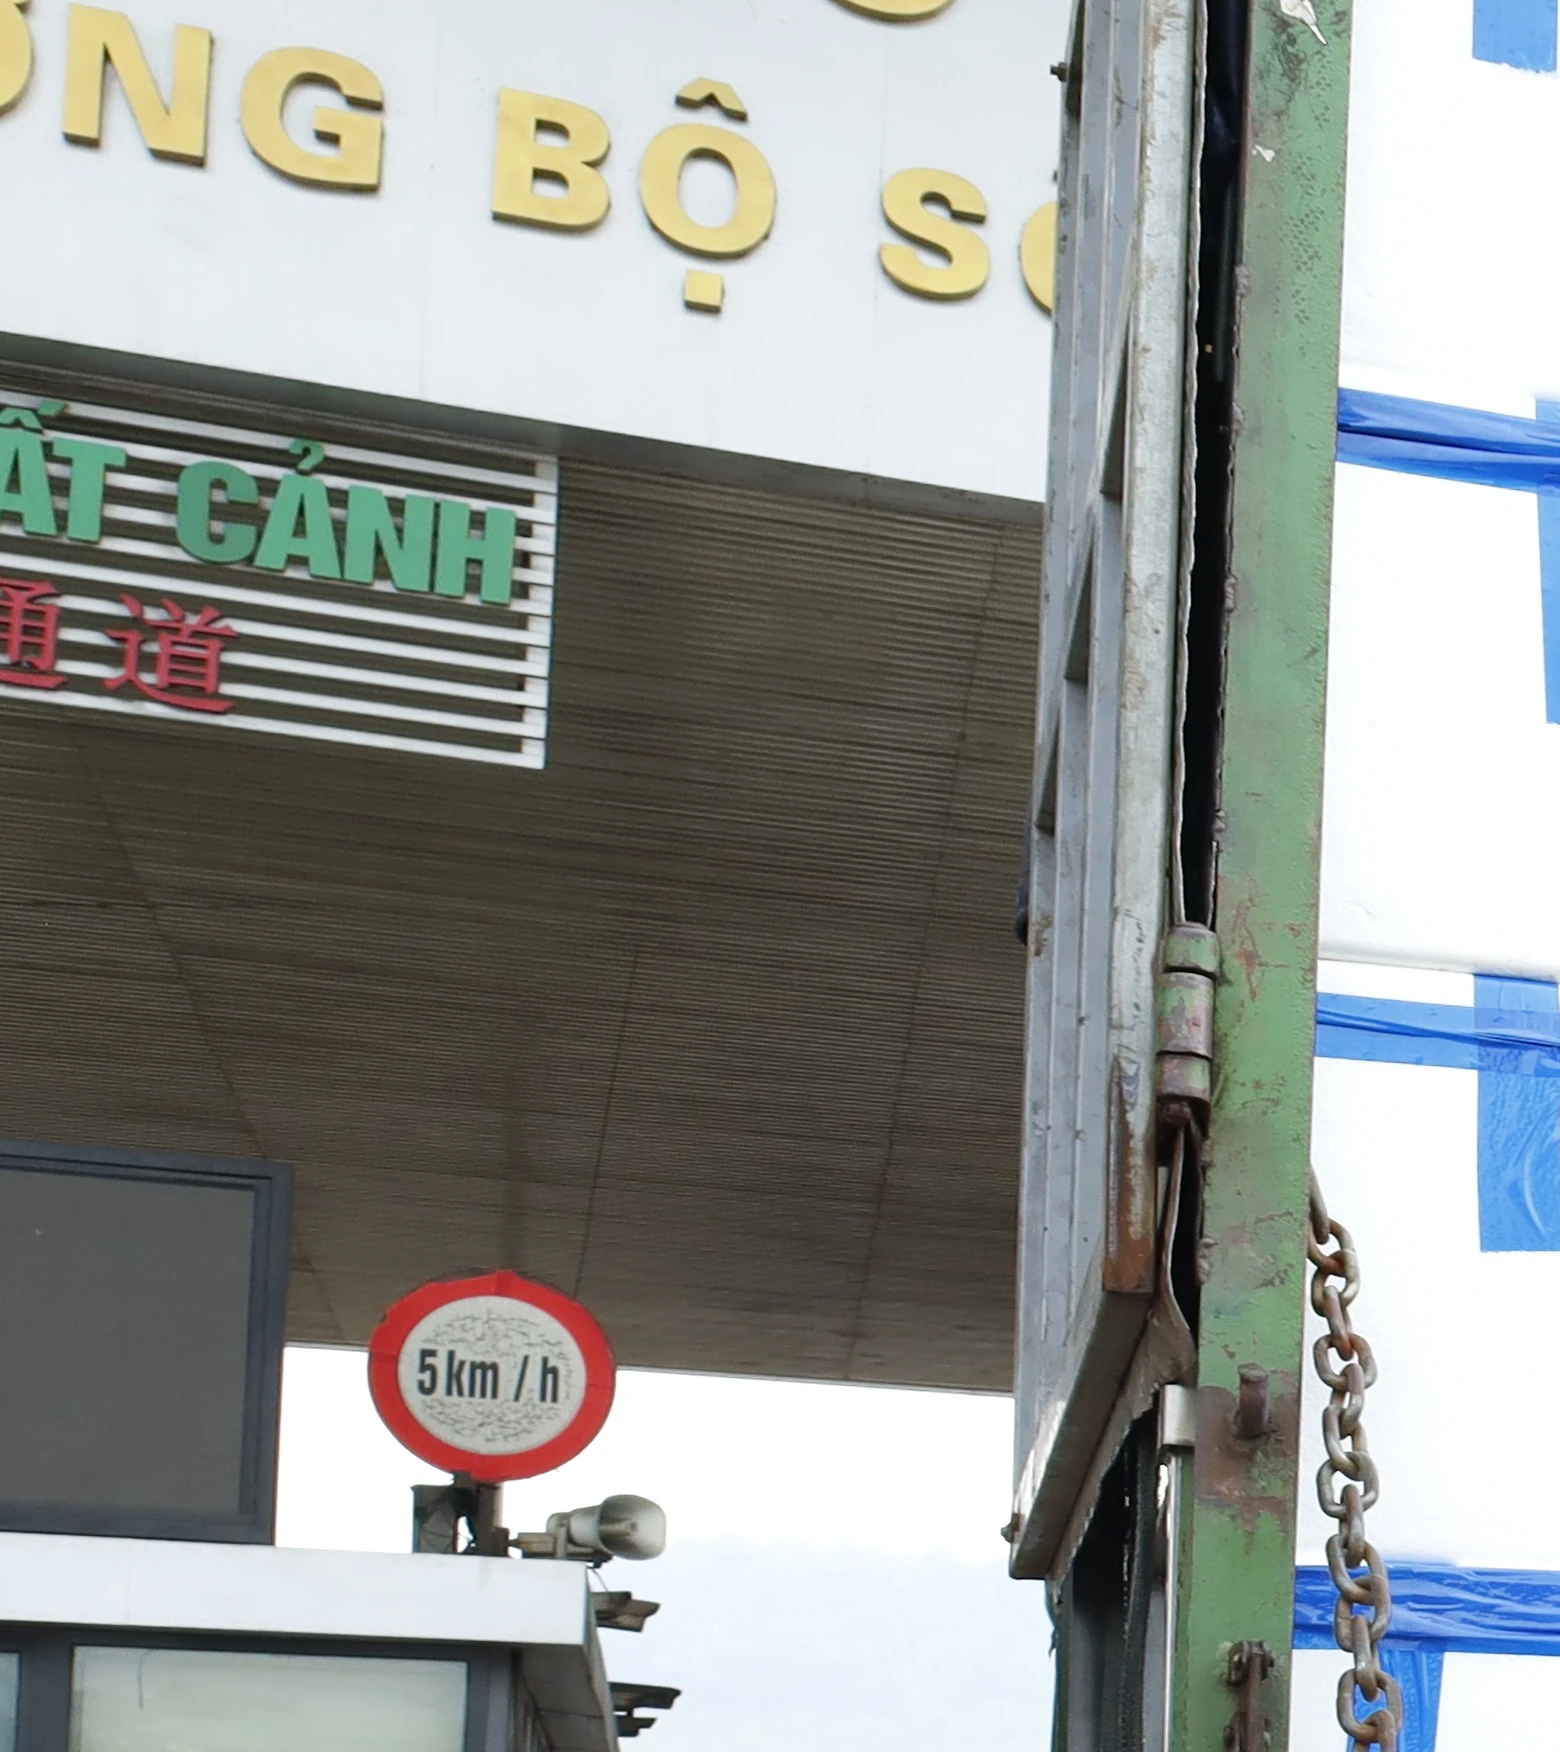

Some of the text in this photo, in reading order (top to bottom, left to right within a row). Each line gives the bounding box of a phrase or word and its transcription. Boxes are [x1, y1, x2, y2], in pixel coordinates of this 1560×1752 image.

[0, 0, 1058, 318] NG BỘ S
[0, 399, 518, 603] ẤT CẢNH
